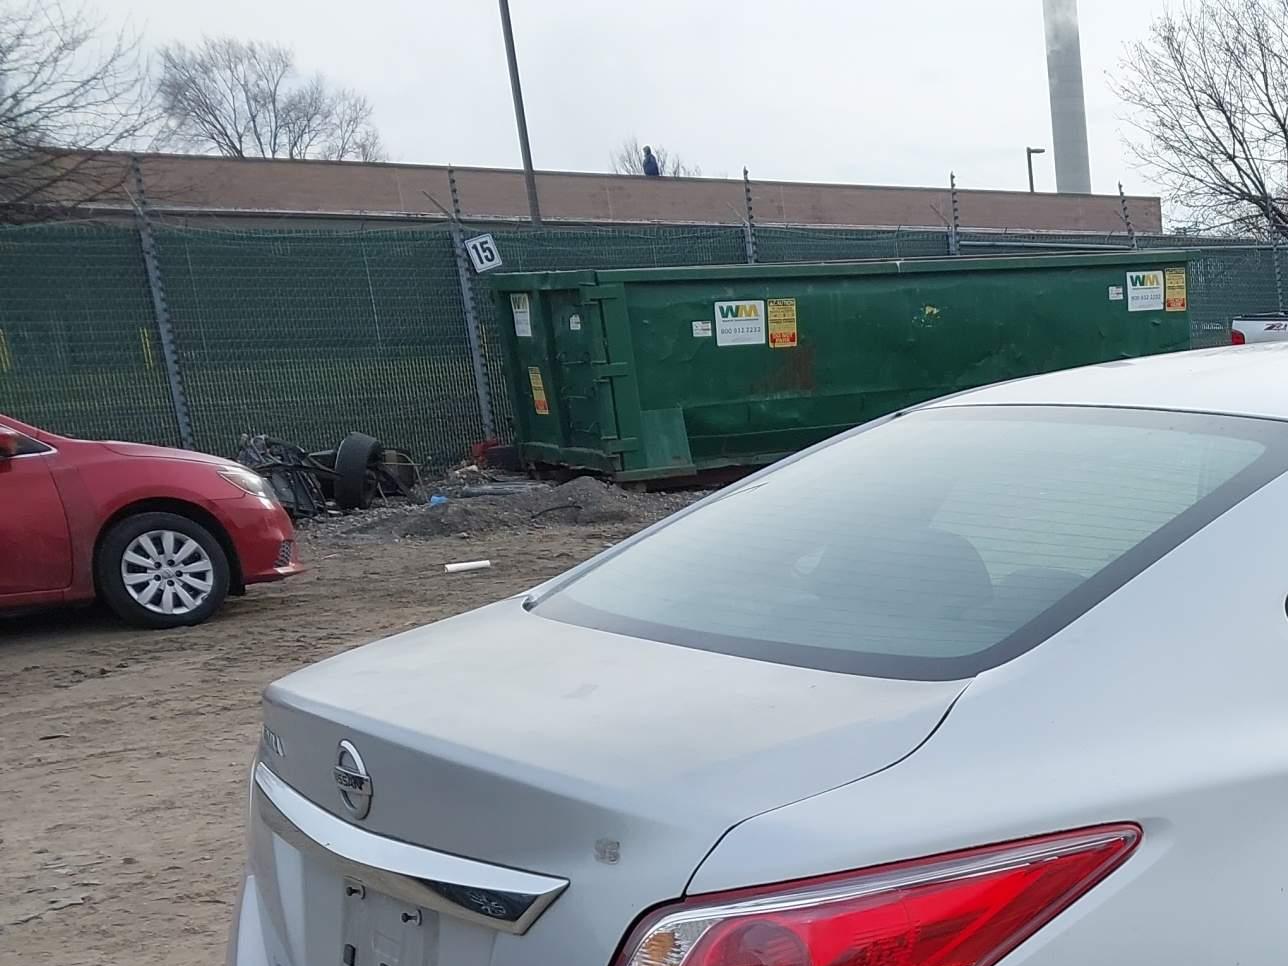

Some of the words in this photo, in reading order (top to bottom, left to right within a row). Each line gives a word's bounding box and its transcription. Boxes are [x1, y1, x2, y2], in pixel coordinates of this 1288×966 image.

[471, 240, 495, 264] 15
[1130, 275, 1160, 286] WM
[719, 304, 759, 318] WM
